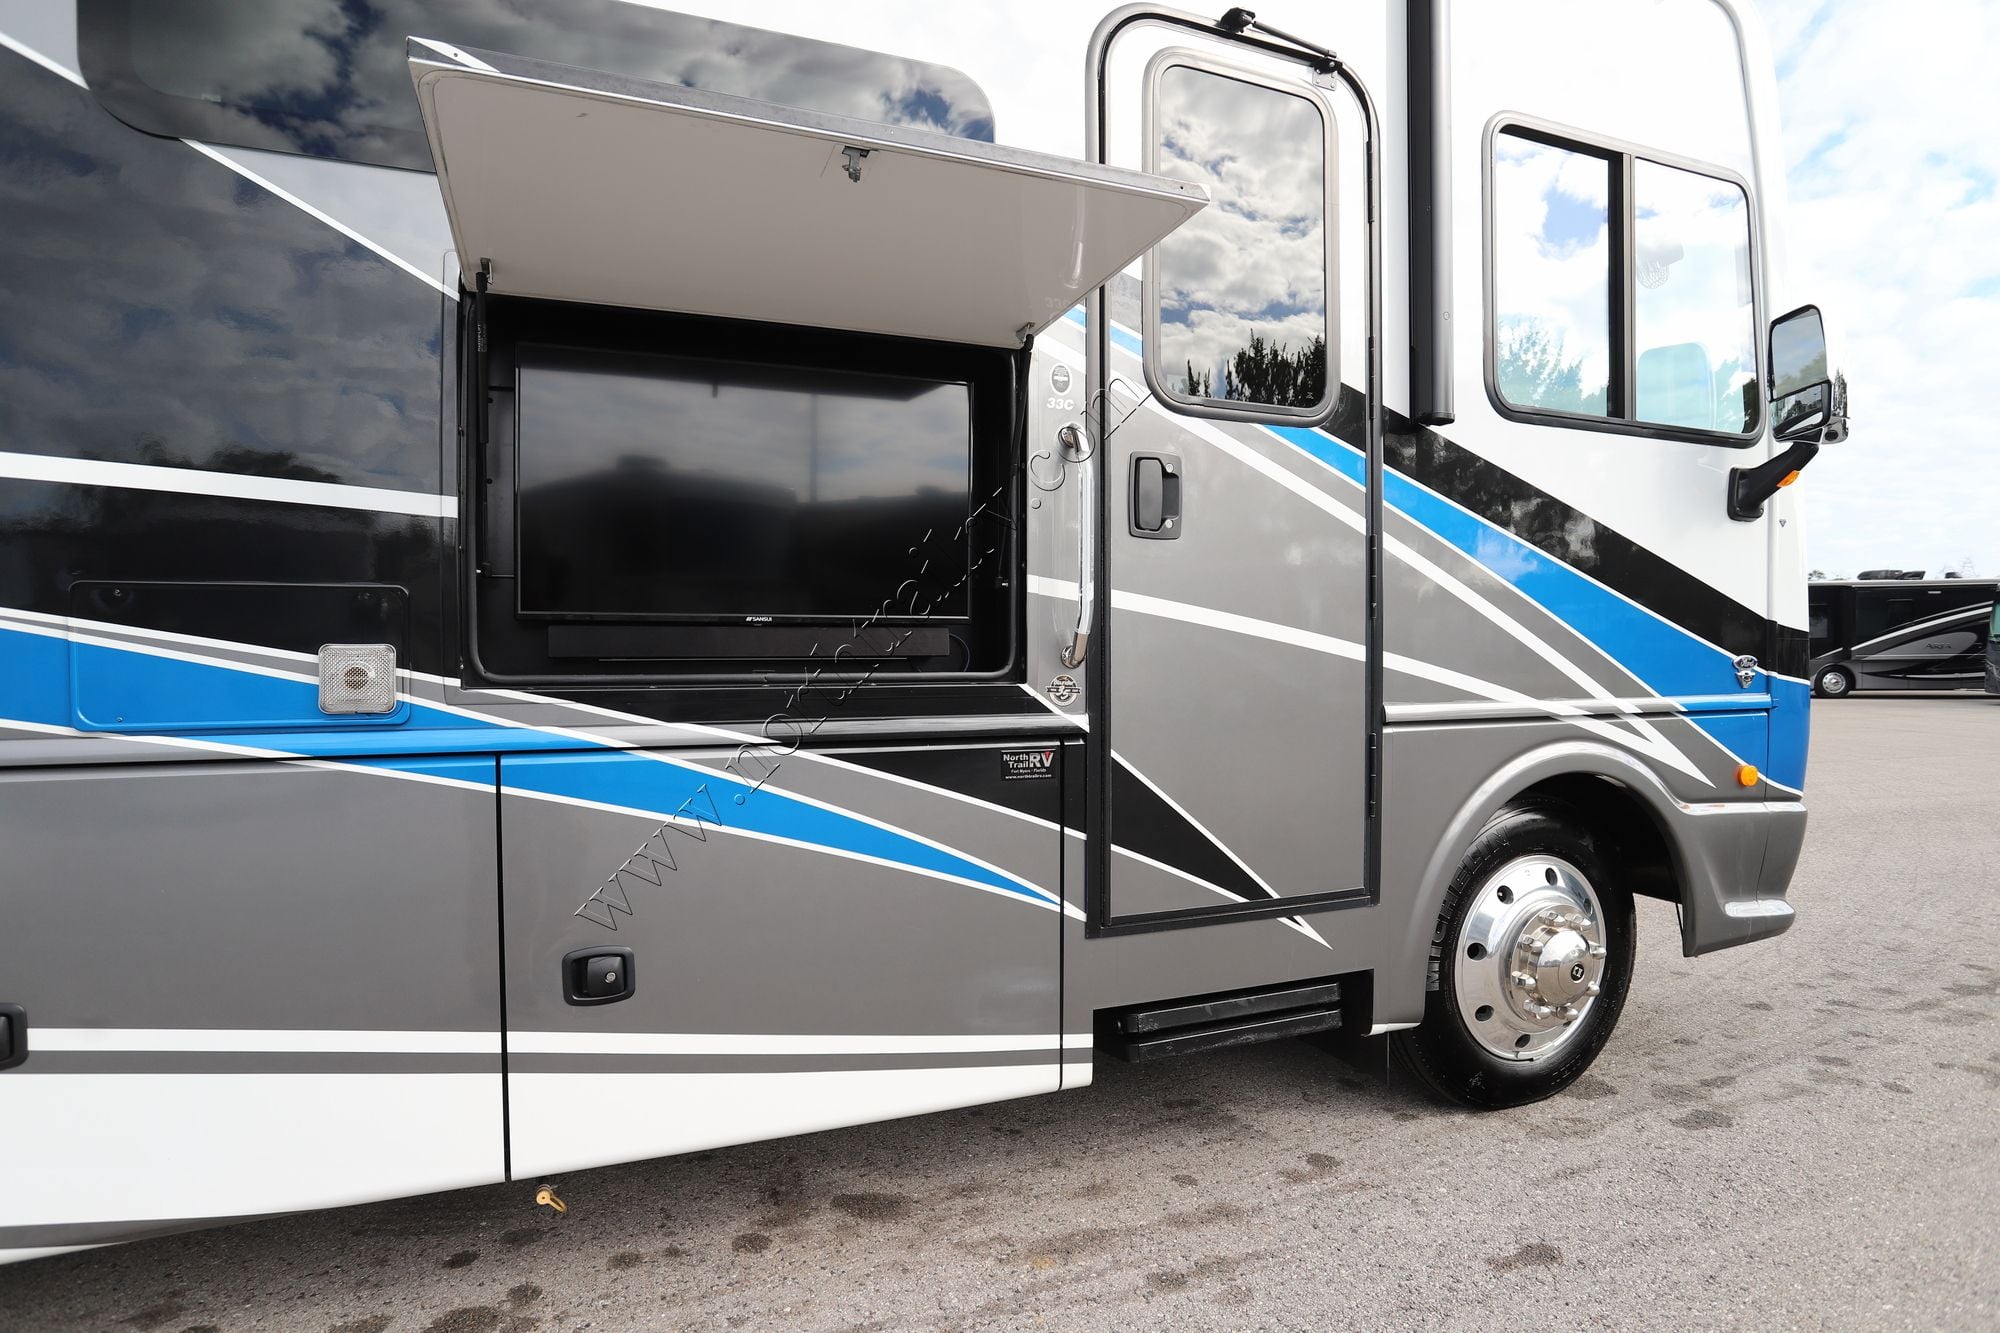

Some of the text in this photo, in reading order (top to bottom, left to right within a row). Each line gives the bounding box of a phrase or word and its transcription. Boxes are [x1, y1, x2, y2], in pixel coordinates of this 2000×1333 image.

[1047, 397, 1074, 410] 33C
[1003, 752, 1054, 768] North RV
[1008, 760, 1029, 768] Trail
[1425, 825, 1513, 991] MICHELIN
